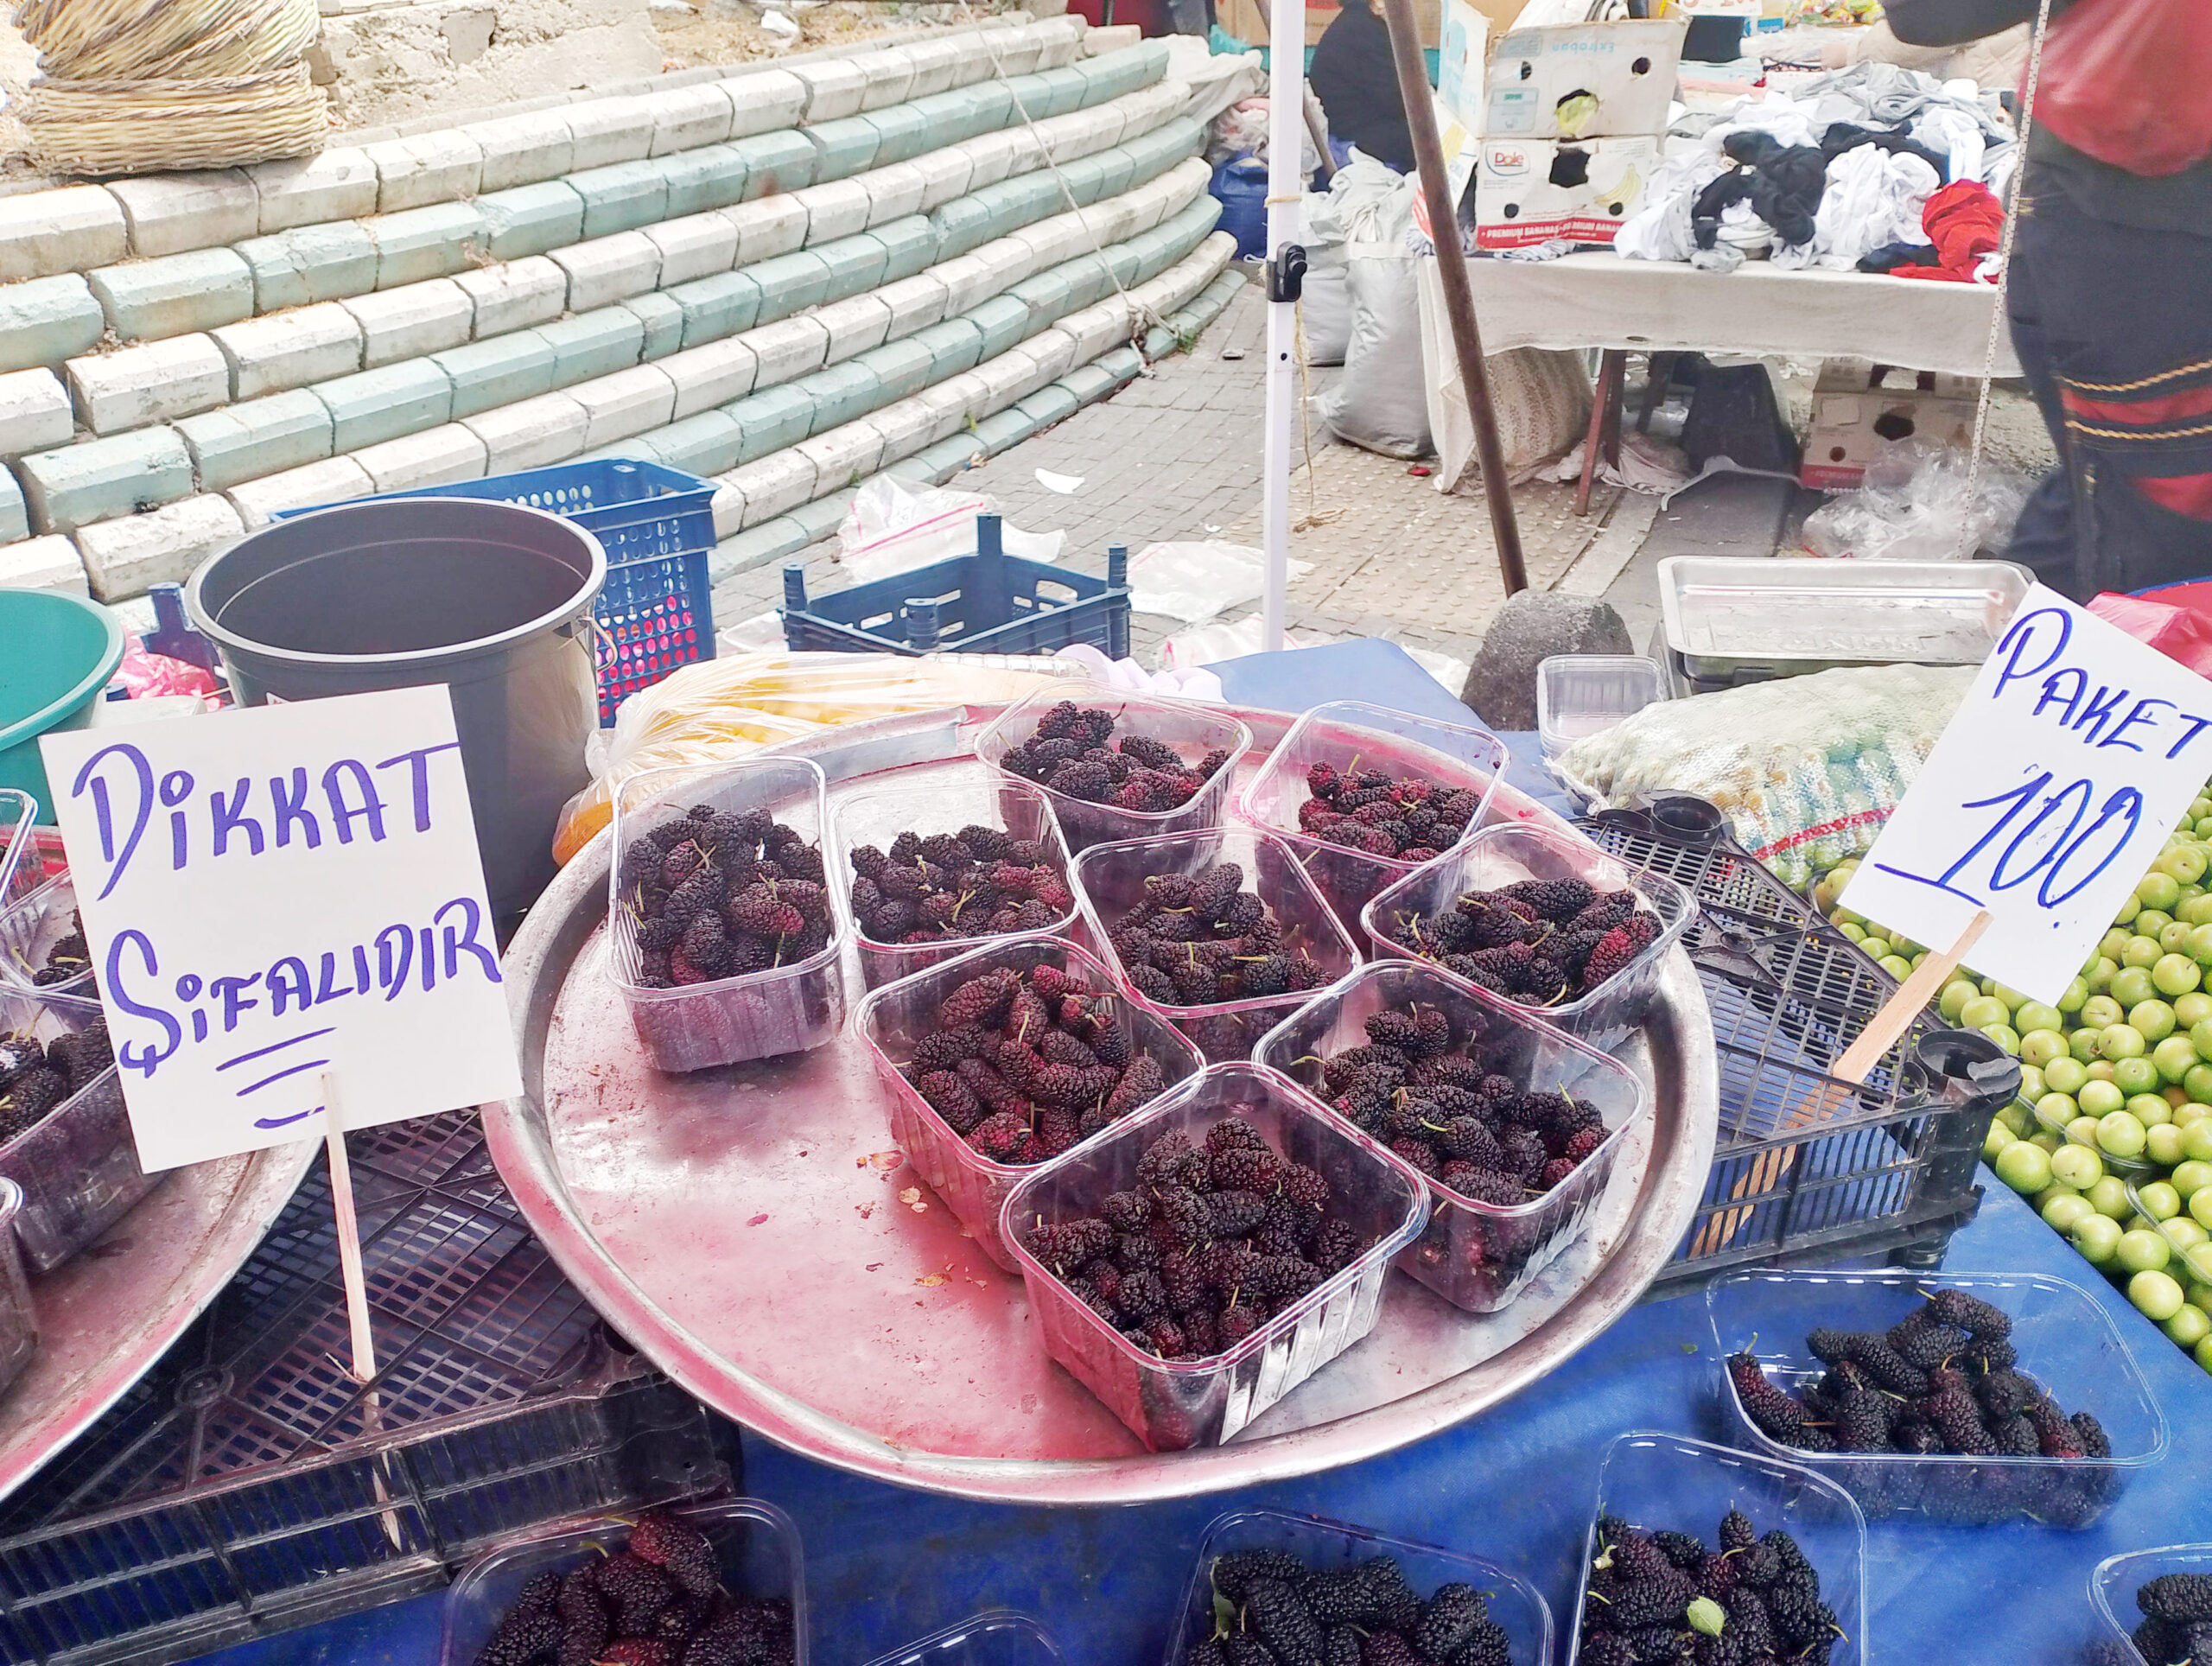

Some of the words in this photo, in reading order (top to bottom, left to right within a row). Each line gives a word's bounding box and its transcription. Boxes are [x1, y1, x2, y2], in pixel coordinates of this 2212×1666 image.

[1495, 151, 1524, 165] Dole
[1486, 227, 1523, 238] PREMIUM
[1993, 607, 2212, 760] PAKET
